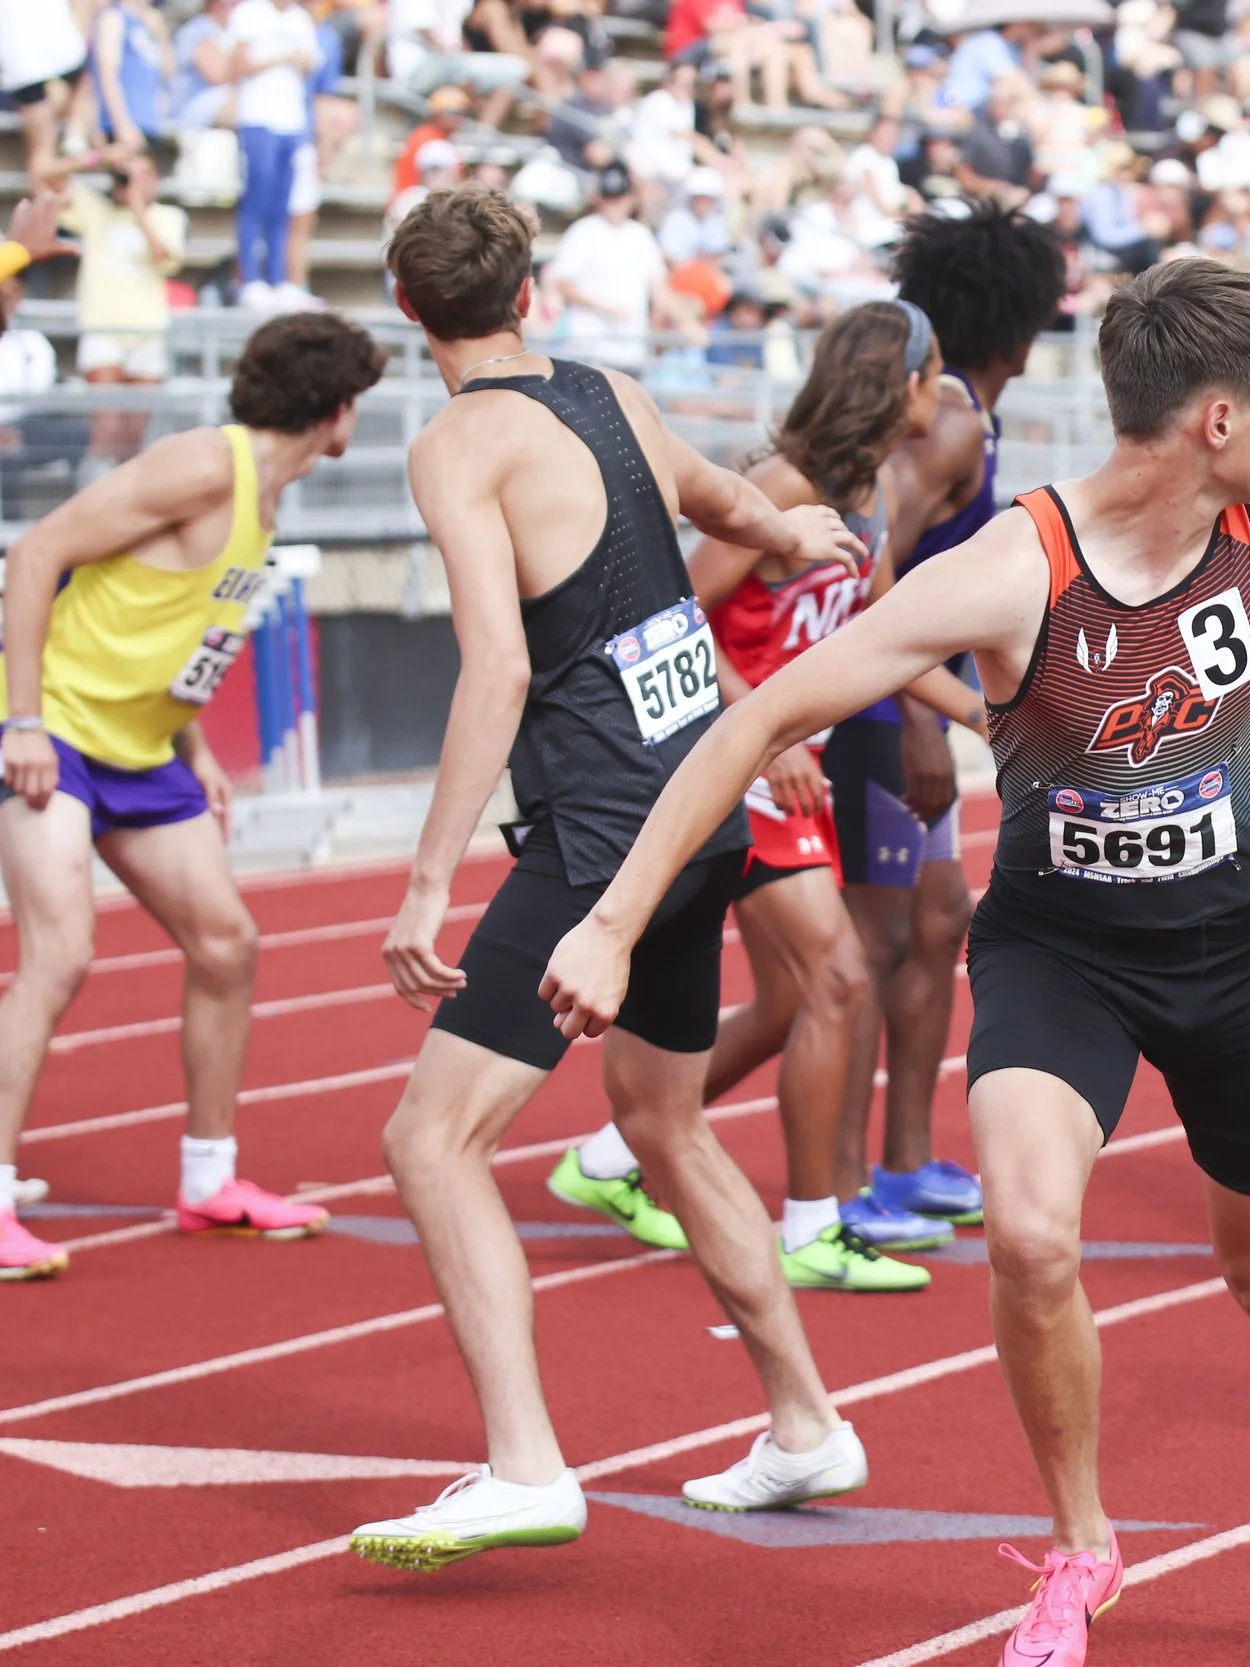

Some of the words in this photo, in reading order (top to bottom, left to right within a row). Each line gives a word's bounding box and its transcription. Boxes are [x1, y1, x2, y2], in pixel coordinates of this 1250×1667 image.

[1191, 604, 1247, 686] 3
[636, 638, 717, 719] 5782
[1100, 790, 1184, 819] ZERO
[1120, 787, 1164, 802] SHOW-ME
[1063, 812, 1216, 868] 5691
